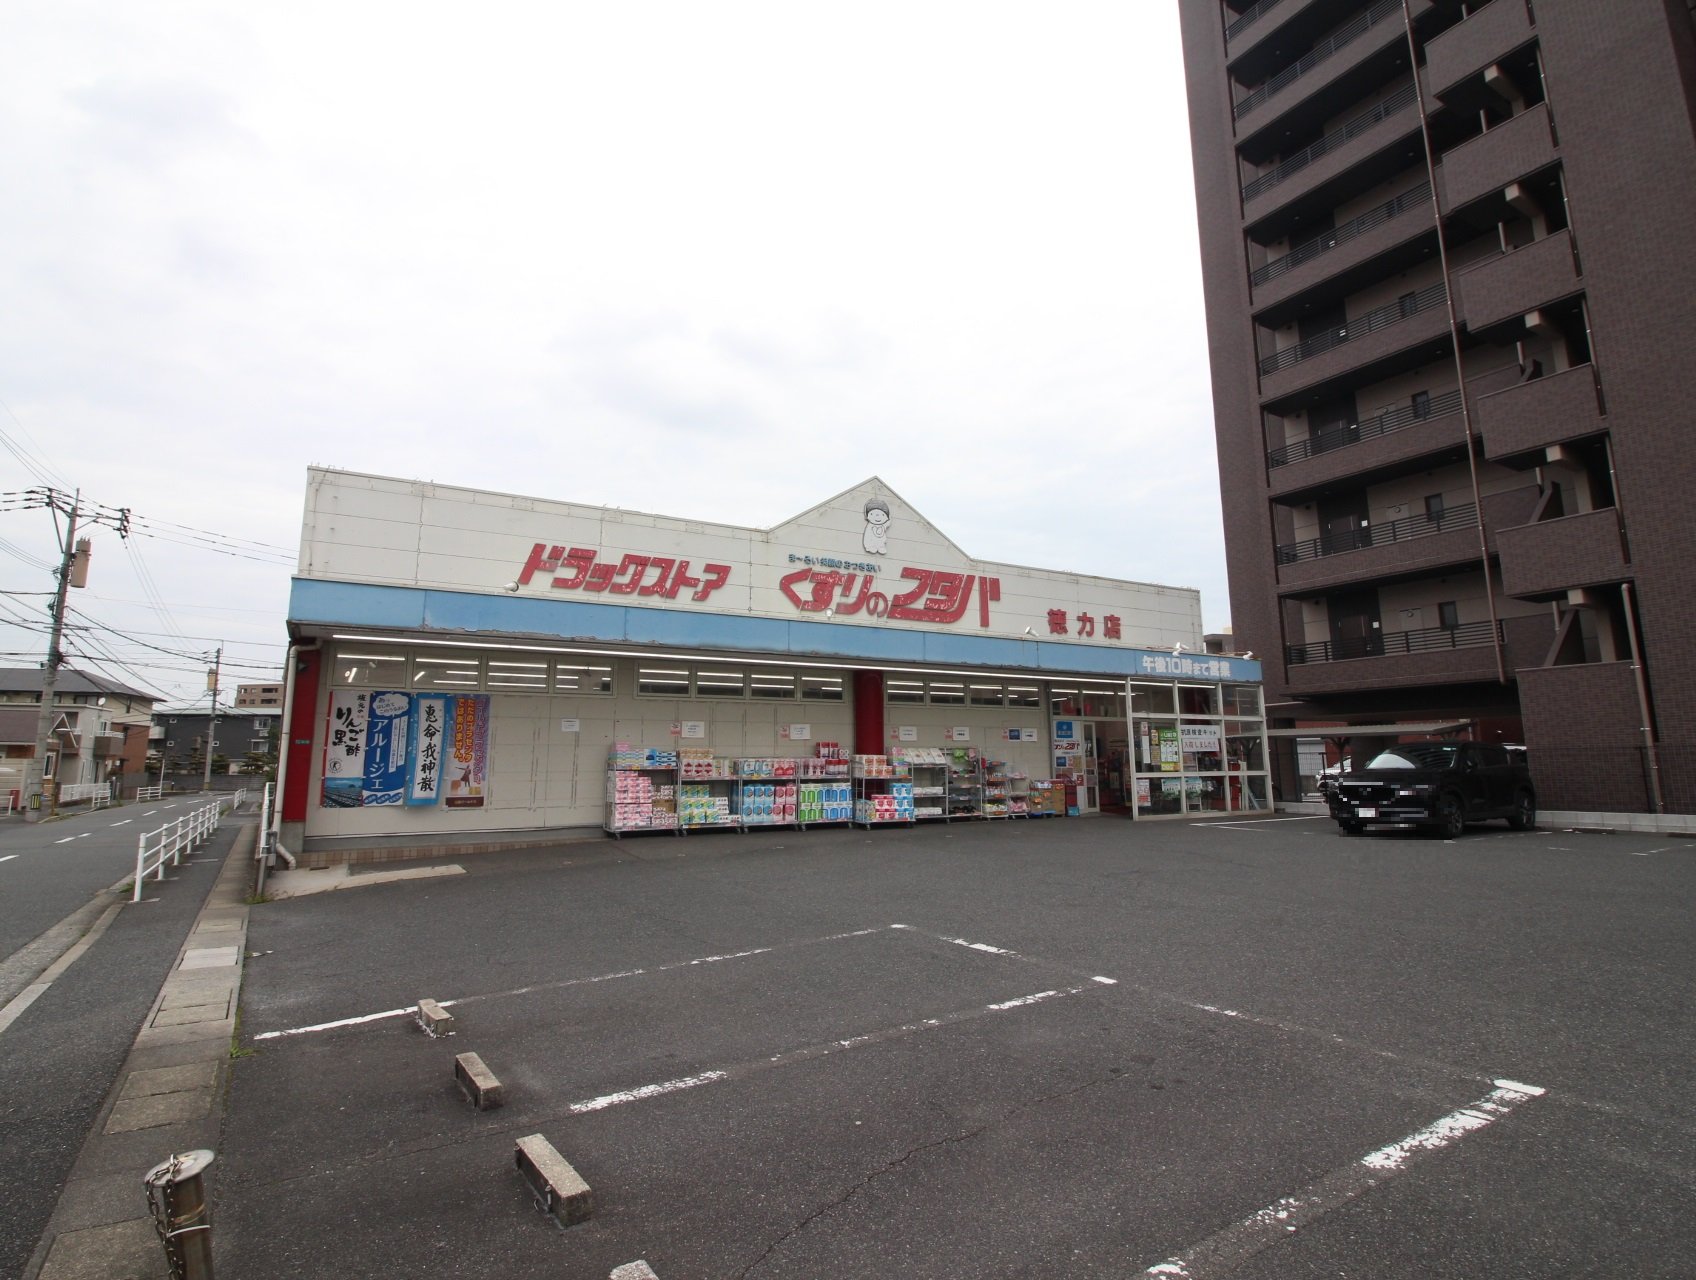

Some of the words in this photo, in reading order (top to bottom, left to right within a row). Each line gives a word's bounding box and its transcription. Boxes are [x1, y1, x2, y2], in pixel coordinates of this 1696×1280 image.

[518, 543, 732, 602] ドラッグストア
[779, 566, 1001, 628] くすりのフタバ
[1047, 608, 1122, 640] 徳力店
[1142, 655, 1231, 678] 午後10時まで営業
[368, 719, 389, 789] アルージェ
